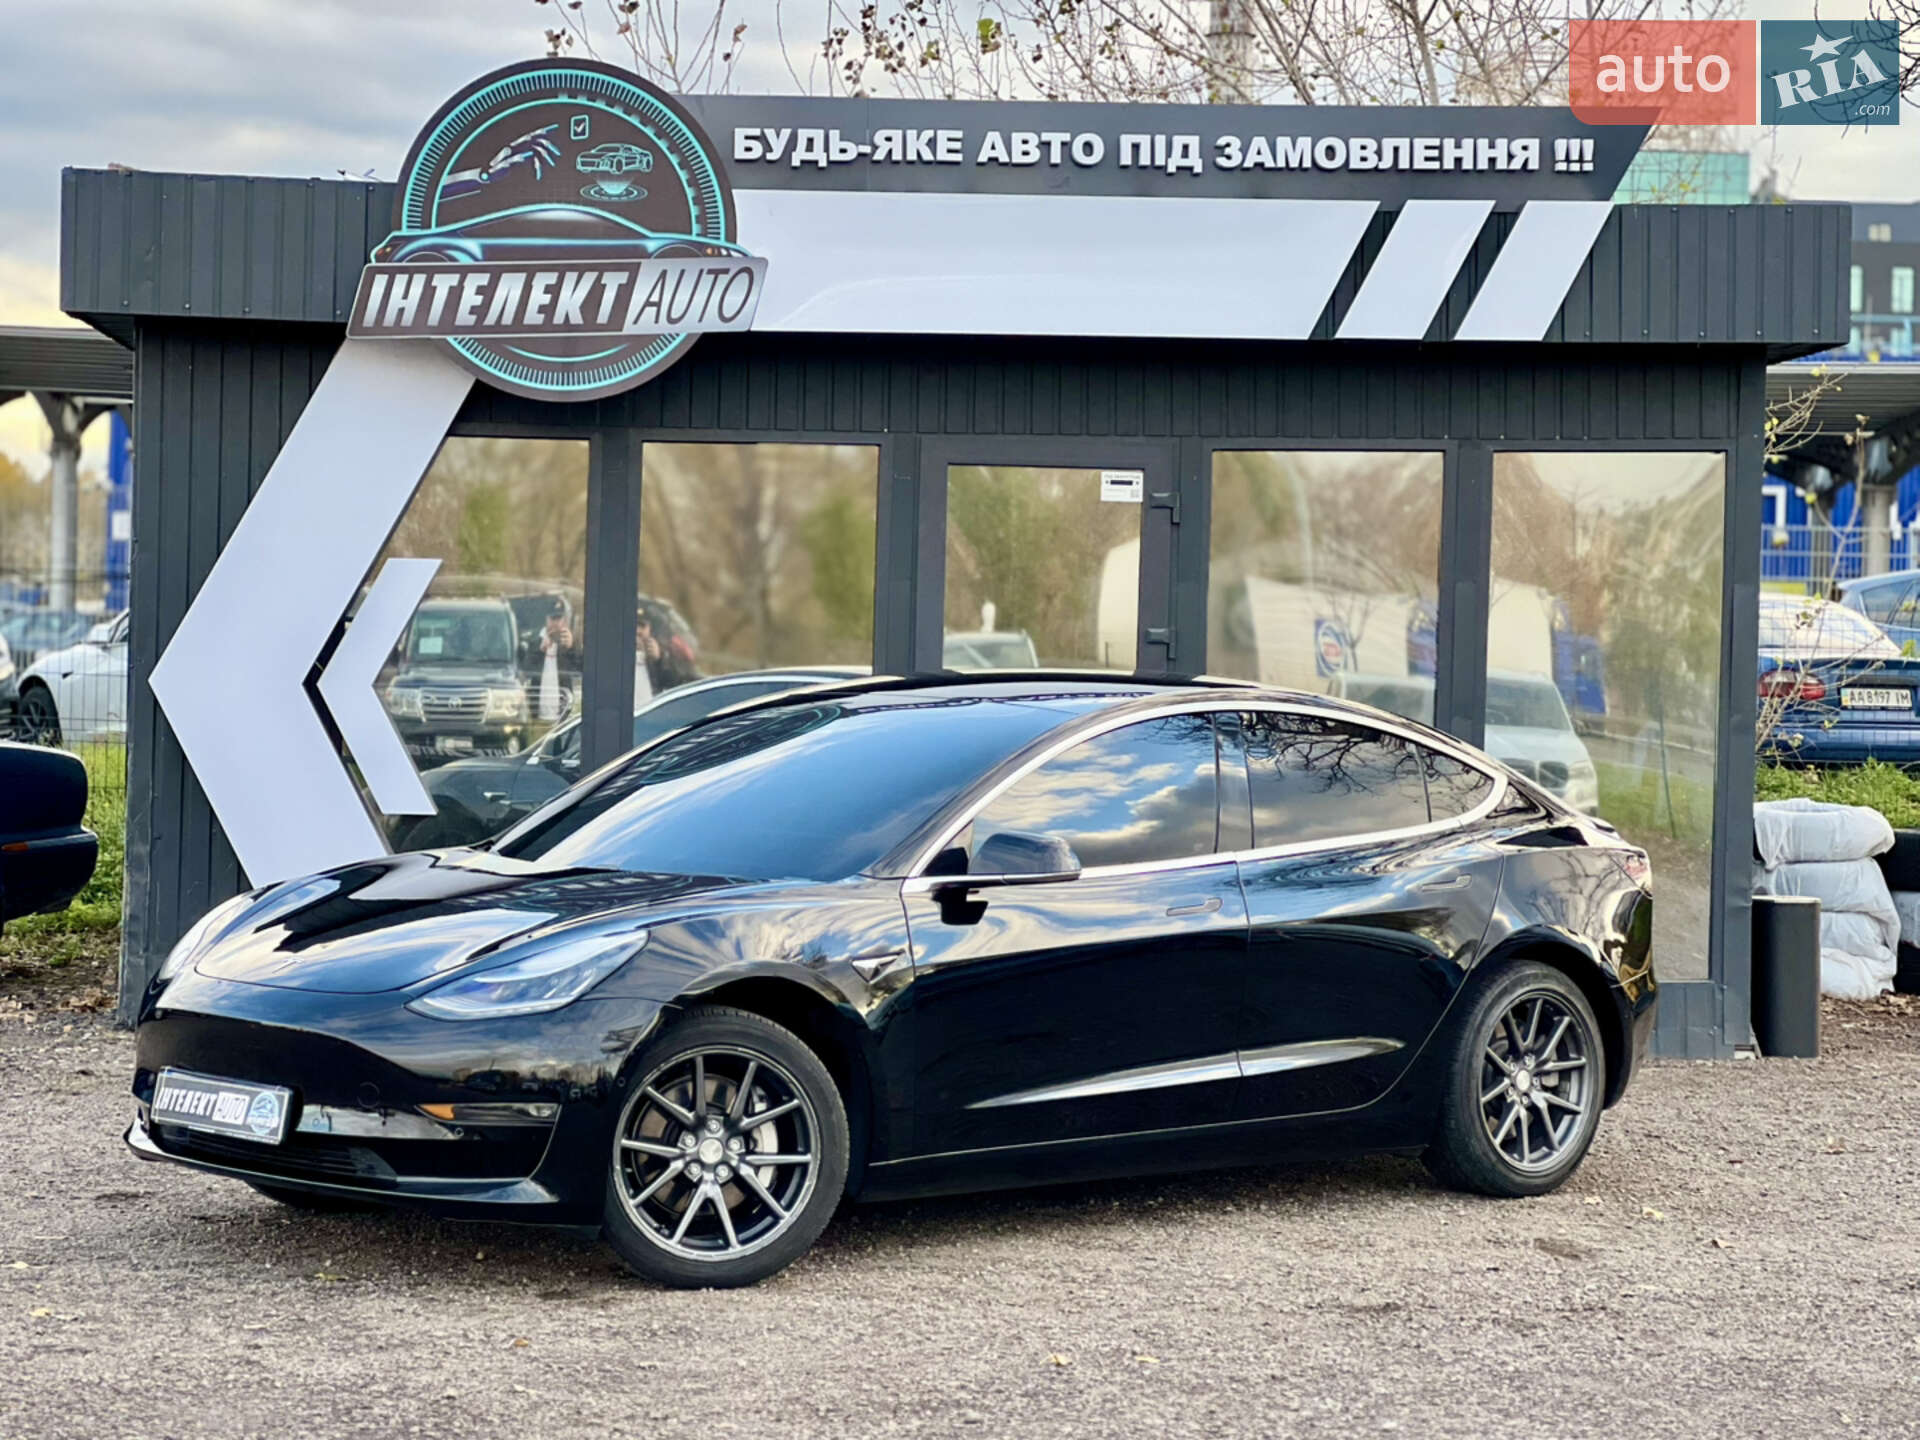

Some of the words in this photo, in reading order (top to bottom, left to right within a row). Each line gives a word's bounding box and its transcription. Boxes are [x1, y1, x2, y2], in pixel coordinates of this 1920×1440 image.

[733, 127, 964, 169] БУДЬ-ЯКЕ
[976, 131, 1106, 167] АВТО
[1119, 133, 1203, 175] ПІД
[1214, 135, 1540, 172] ЗАМОВЛЕННЯ
[1553, 138, 1595, 172] !!!
[362, 269, 631, 329] ІНТЕЛЕКТ
[632, 265, 754, 325] AUTO
